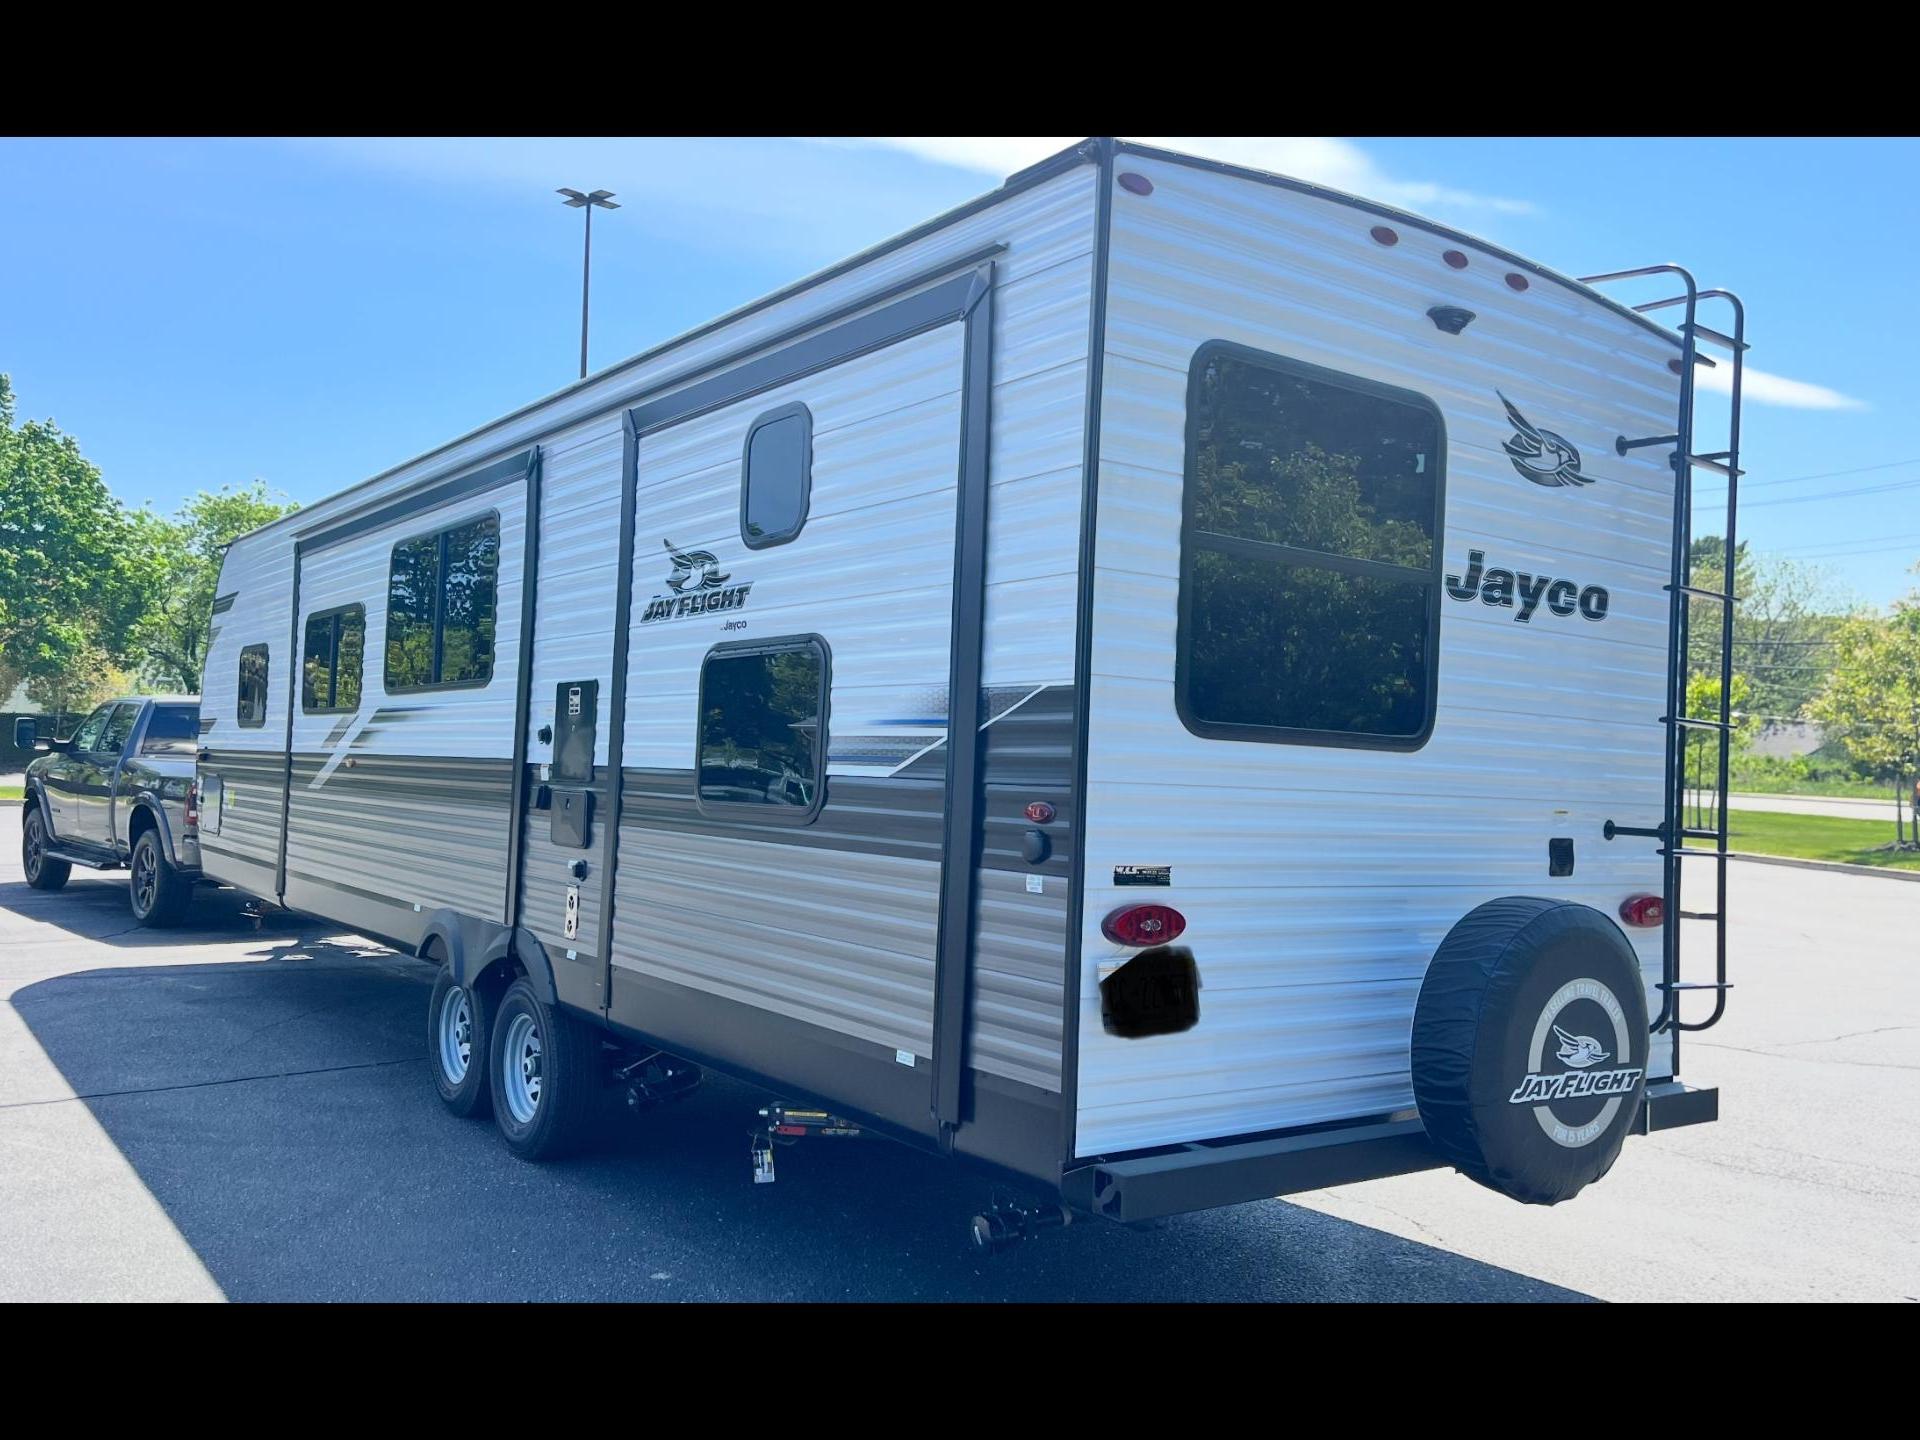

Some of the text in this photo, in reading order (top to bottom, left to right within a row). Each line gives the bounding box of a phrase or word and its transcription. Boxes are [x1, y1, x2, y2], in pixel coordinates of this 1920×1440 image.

[1445, 549, 1610, 623] Jayco
[675, 585, 752, 618] FLIGHT
[724, 620, 747, 632] Jayco
[1556, 1069, 1642, 1098] FLIGHT
[1576, 1121, 1600, 1142] YEARS
